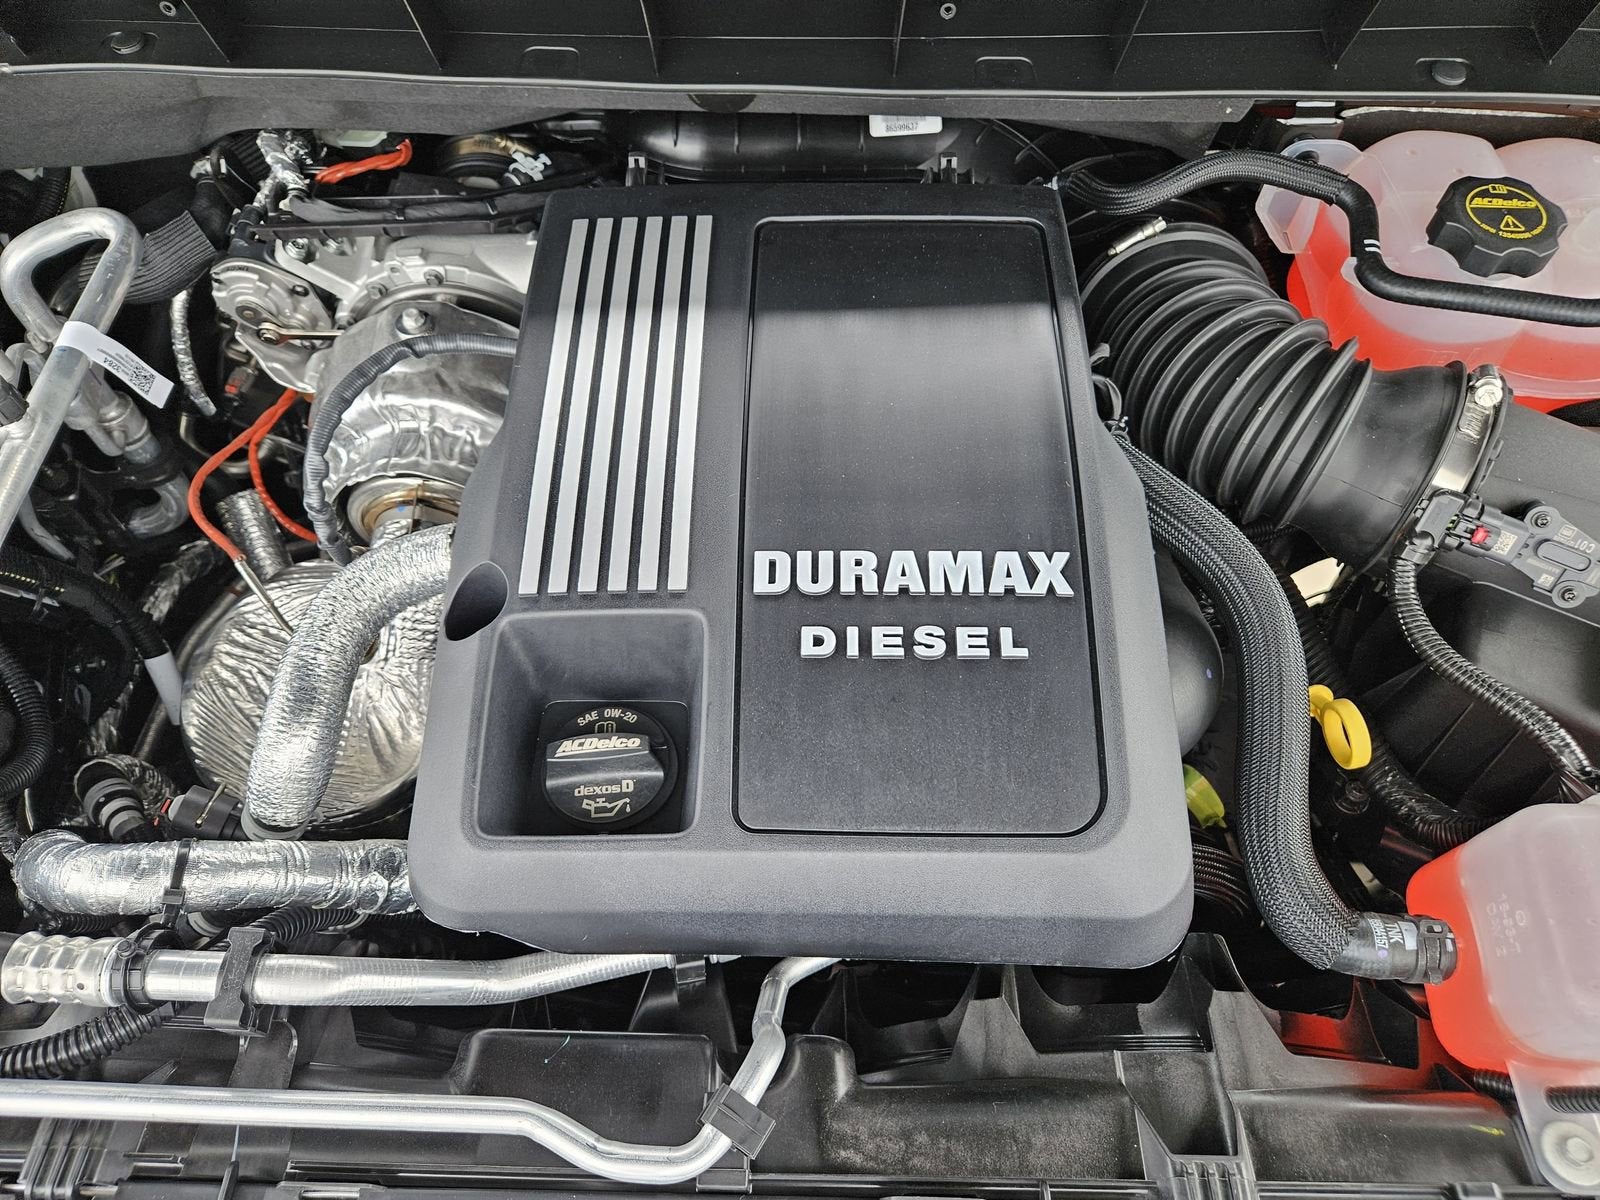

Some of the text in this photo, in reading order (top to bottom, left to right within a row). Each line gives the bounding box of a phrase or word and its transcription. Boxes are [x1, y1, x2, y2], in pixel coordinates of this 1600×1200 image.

[1470, 197, 1538, 208] ACDelco
[752, 550, 1075, 597] DURAMAX
[800, 625, 1029, 660] DIESEL
[577, 708, 638, 726] SAE 0W-20
[556, 735, 641, 754] ACDelco
[1384, 922, 1404, 944] TNK
